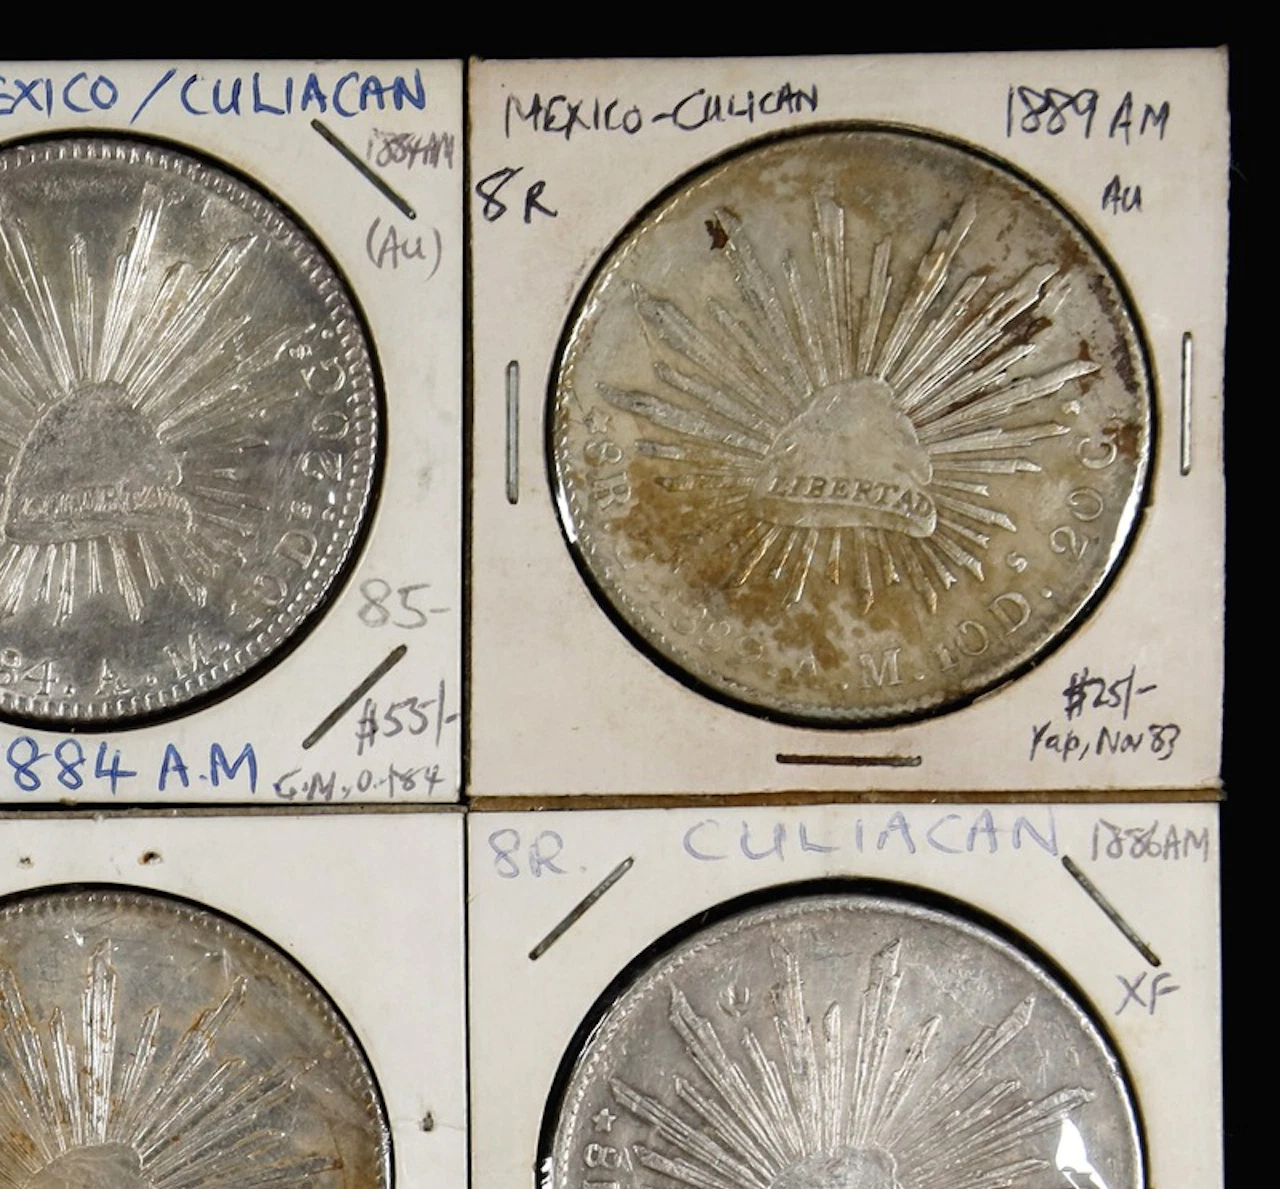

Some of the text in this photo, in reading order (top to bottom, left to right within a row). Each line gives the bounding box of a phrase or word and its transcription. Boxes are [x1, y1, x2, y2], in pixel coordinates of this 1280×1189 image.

[1005, 84, 1170, 141] 1889 AM
[768, 474, 937, 518] LIBERTAD
[158, 741, 259, 791] A.M
[682, 809, 1060, 862] CULIACAN
[1115, 974, 1182, 1016] XF
